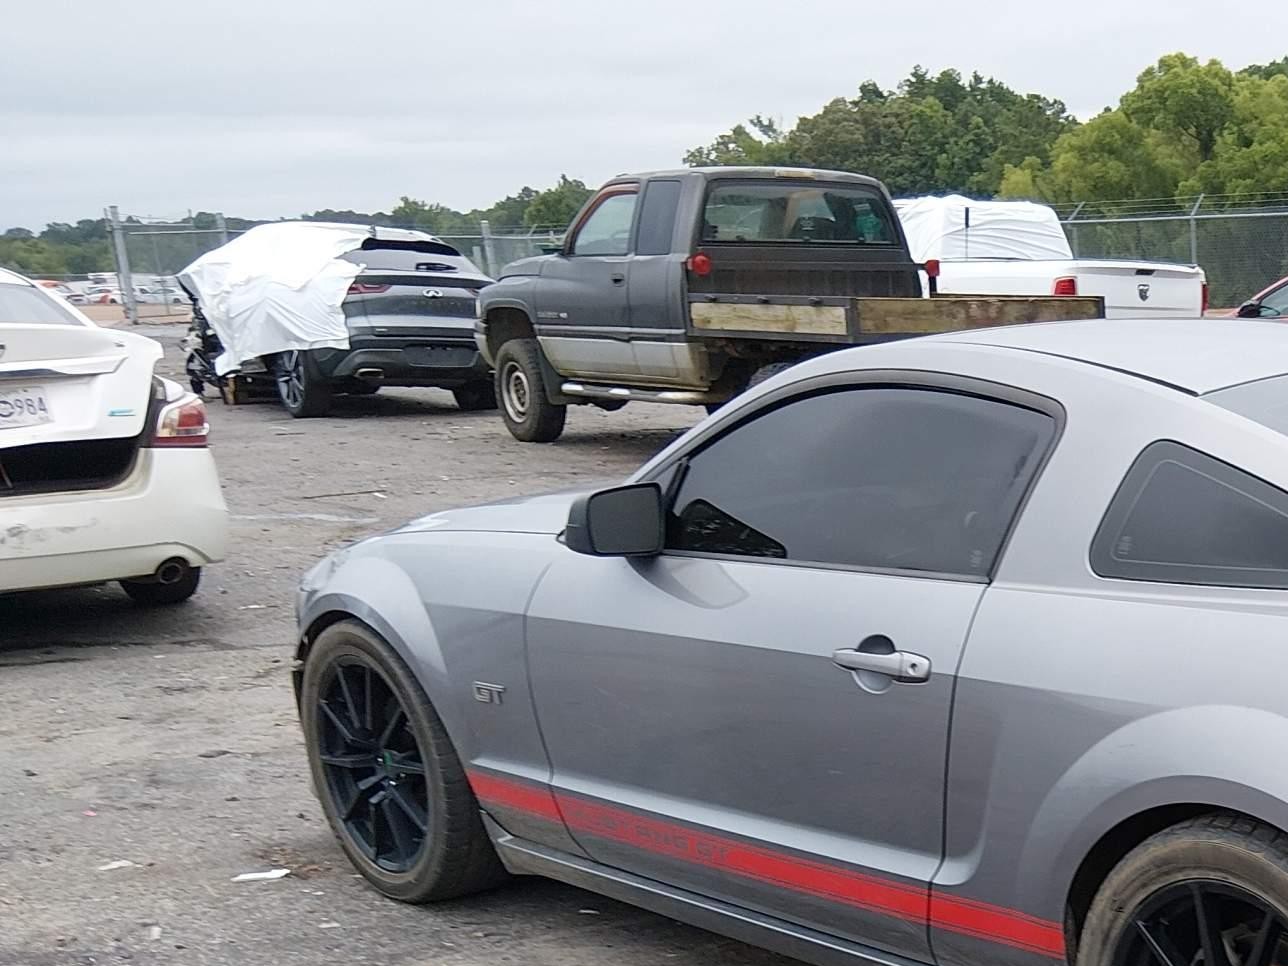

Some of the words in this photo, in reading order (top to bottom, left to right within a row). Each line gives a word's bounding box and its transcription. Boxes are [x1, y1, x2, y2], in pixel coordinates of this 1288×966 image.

[14, 397, 49, 416] 984
[473, 680, 505, 705] GT
[563, 806, 689, 849] STANG
